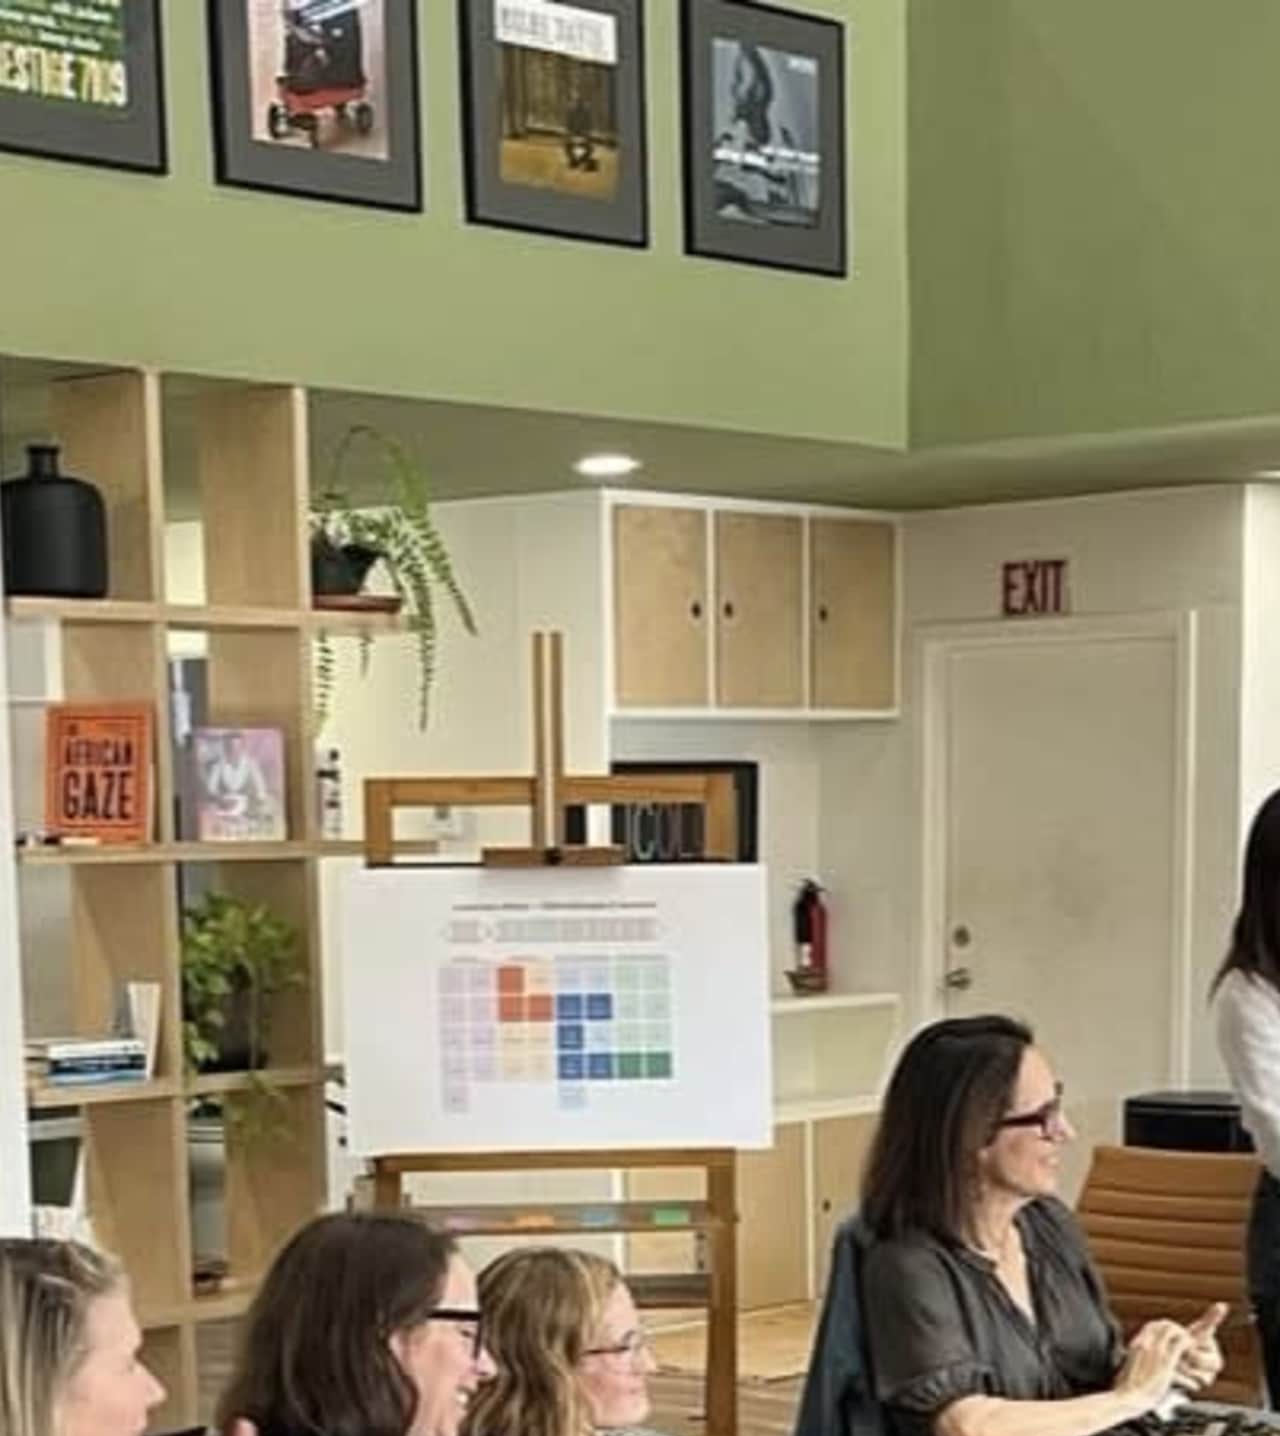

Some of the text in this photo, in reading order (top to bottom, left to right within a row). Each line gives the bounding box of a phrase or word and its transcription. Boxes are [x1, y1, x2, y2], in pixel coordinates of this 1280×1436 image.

[1002, 560, 1066, 616] EXIT
[65, 738, 134, 766] AFRICAN
[64, 770, 134, 819] GAZE
